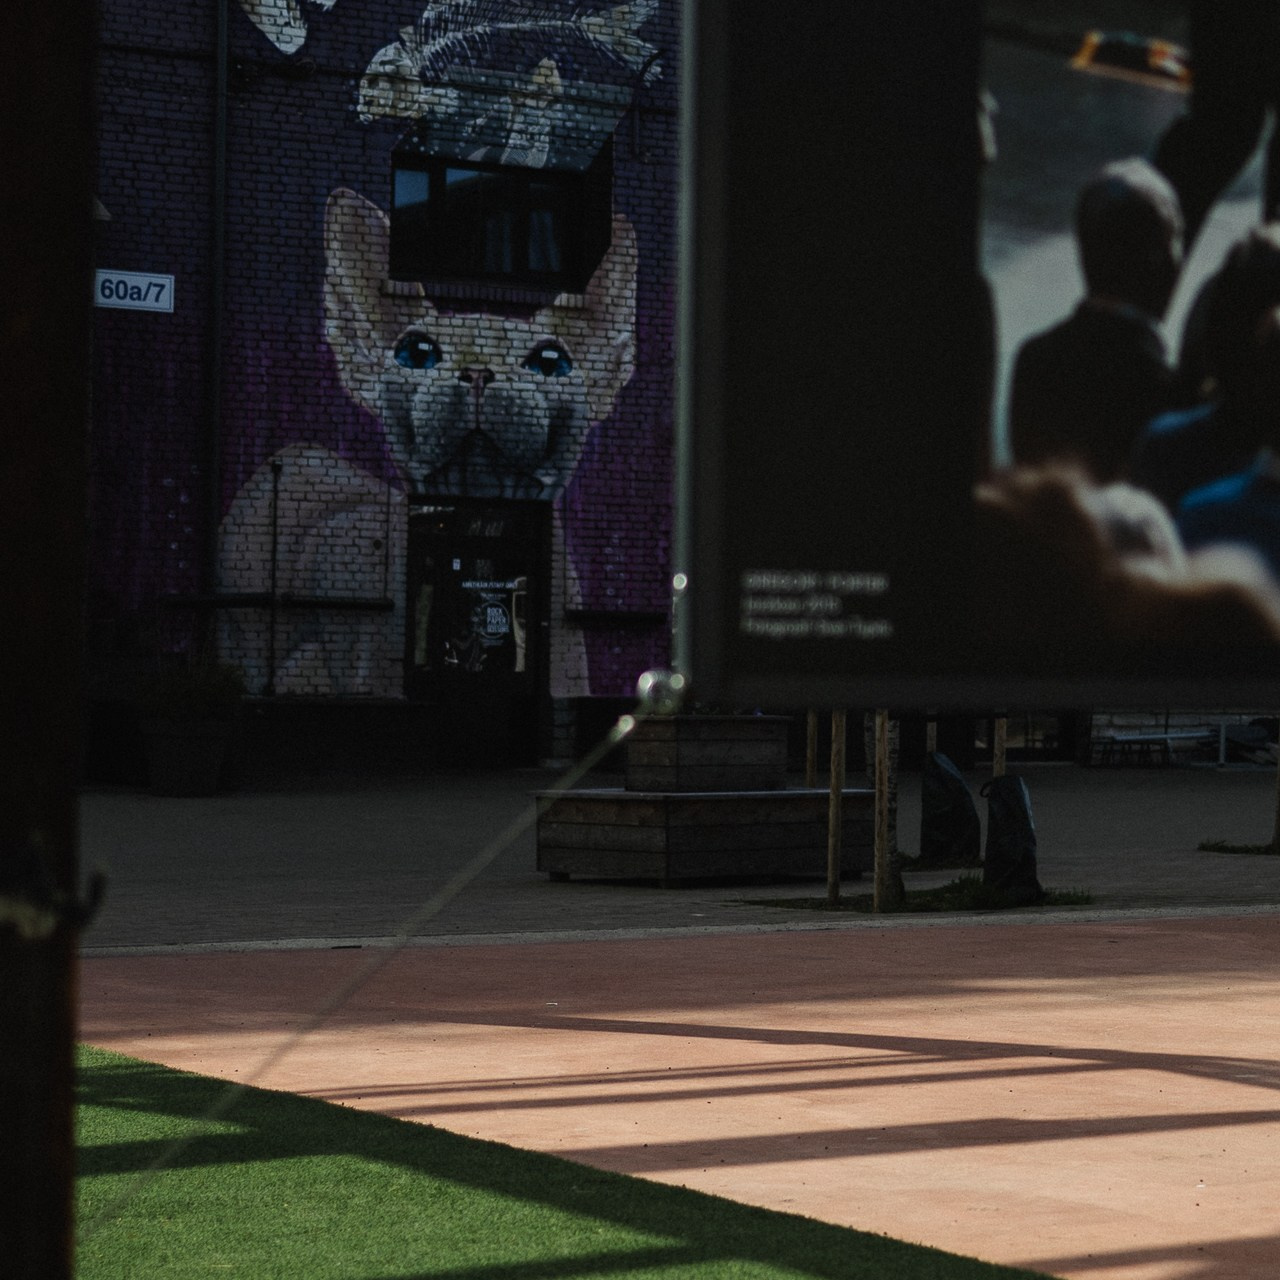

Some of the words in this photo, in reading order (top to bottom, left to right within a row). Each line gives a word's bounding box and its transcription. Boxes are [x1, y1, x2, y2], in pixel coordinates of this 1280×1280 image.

[100, 279, 166, 303] 60a/7
[486, 607, 503, 616] ROCK
[486, 615, 507, 624] PAPER
